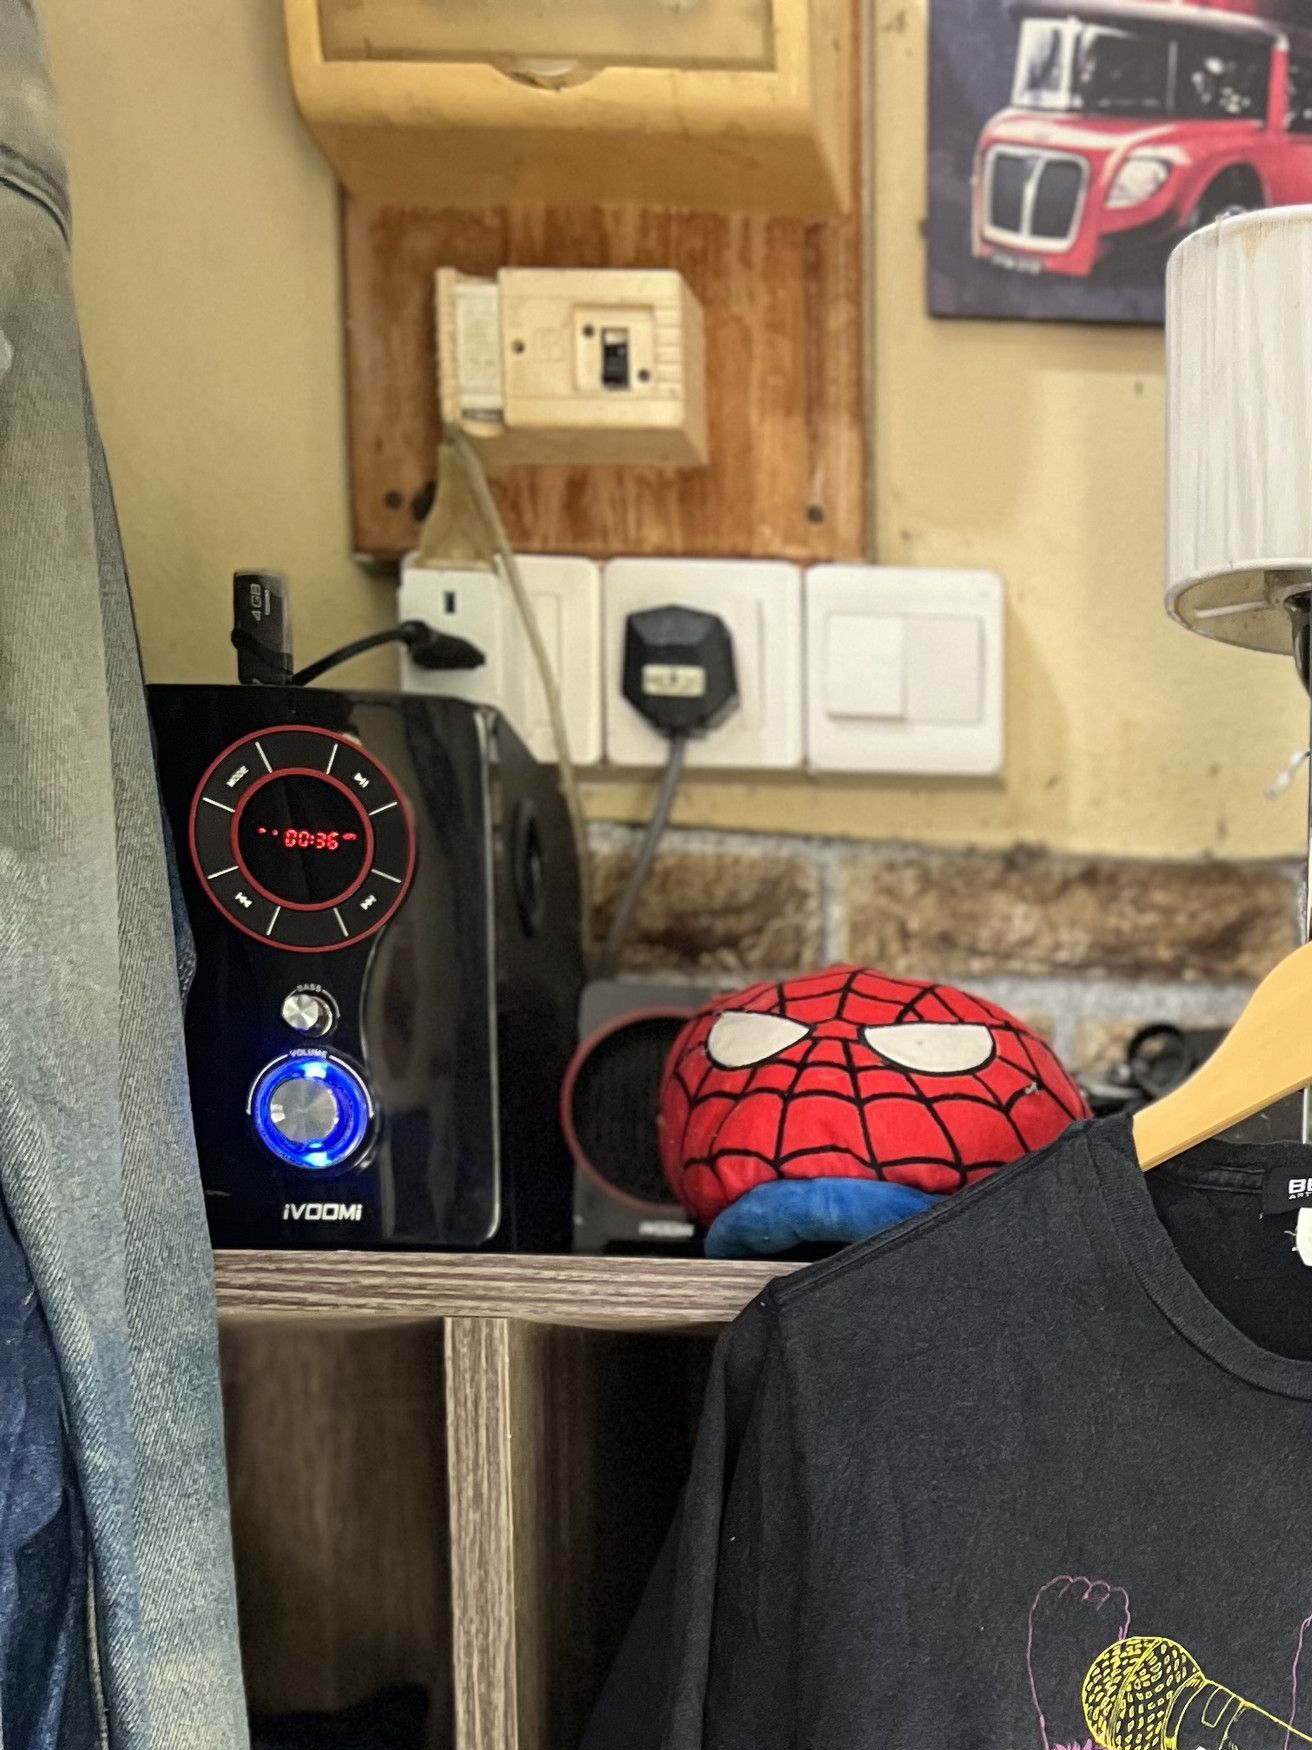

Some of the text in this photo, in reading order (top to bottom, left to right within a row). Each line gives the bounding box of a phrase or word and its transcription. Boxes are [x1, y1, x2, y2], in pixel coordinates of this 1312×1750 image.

[250, 583, 263, 622] 4GB
[226, 765, 249, 788] MODE
[296, 983, 322, 993] BASS
[289, 1049, 328, 1059] VOLUME
[1288, 1191, 1312, 1200] ART
